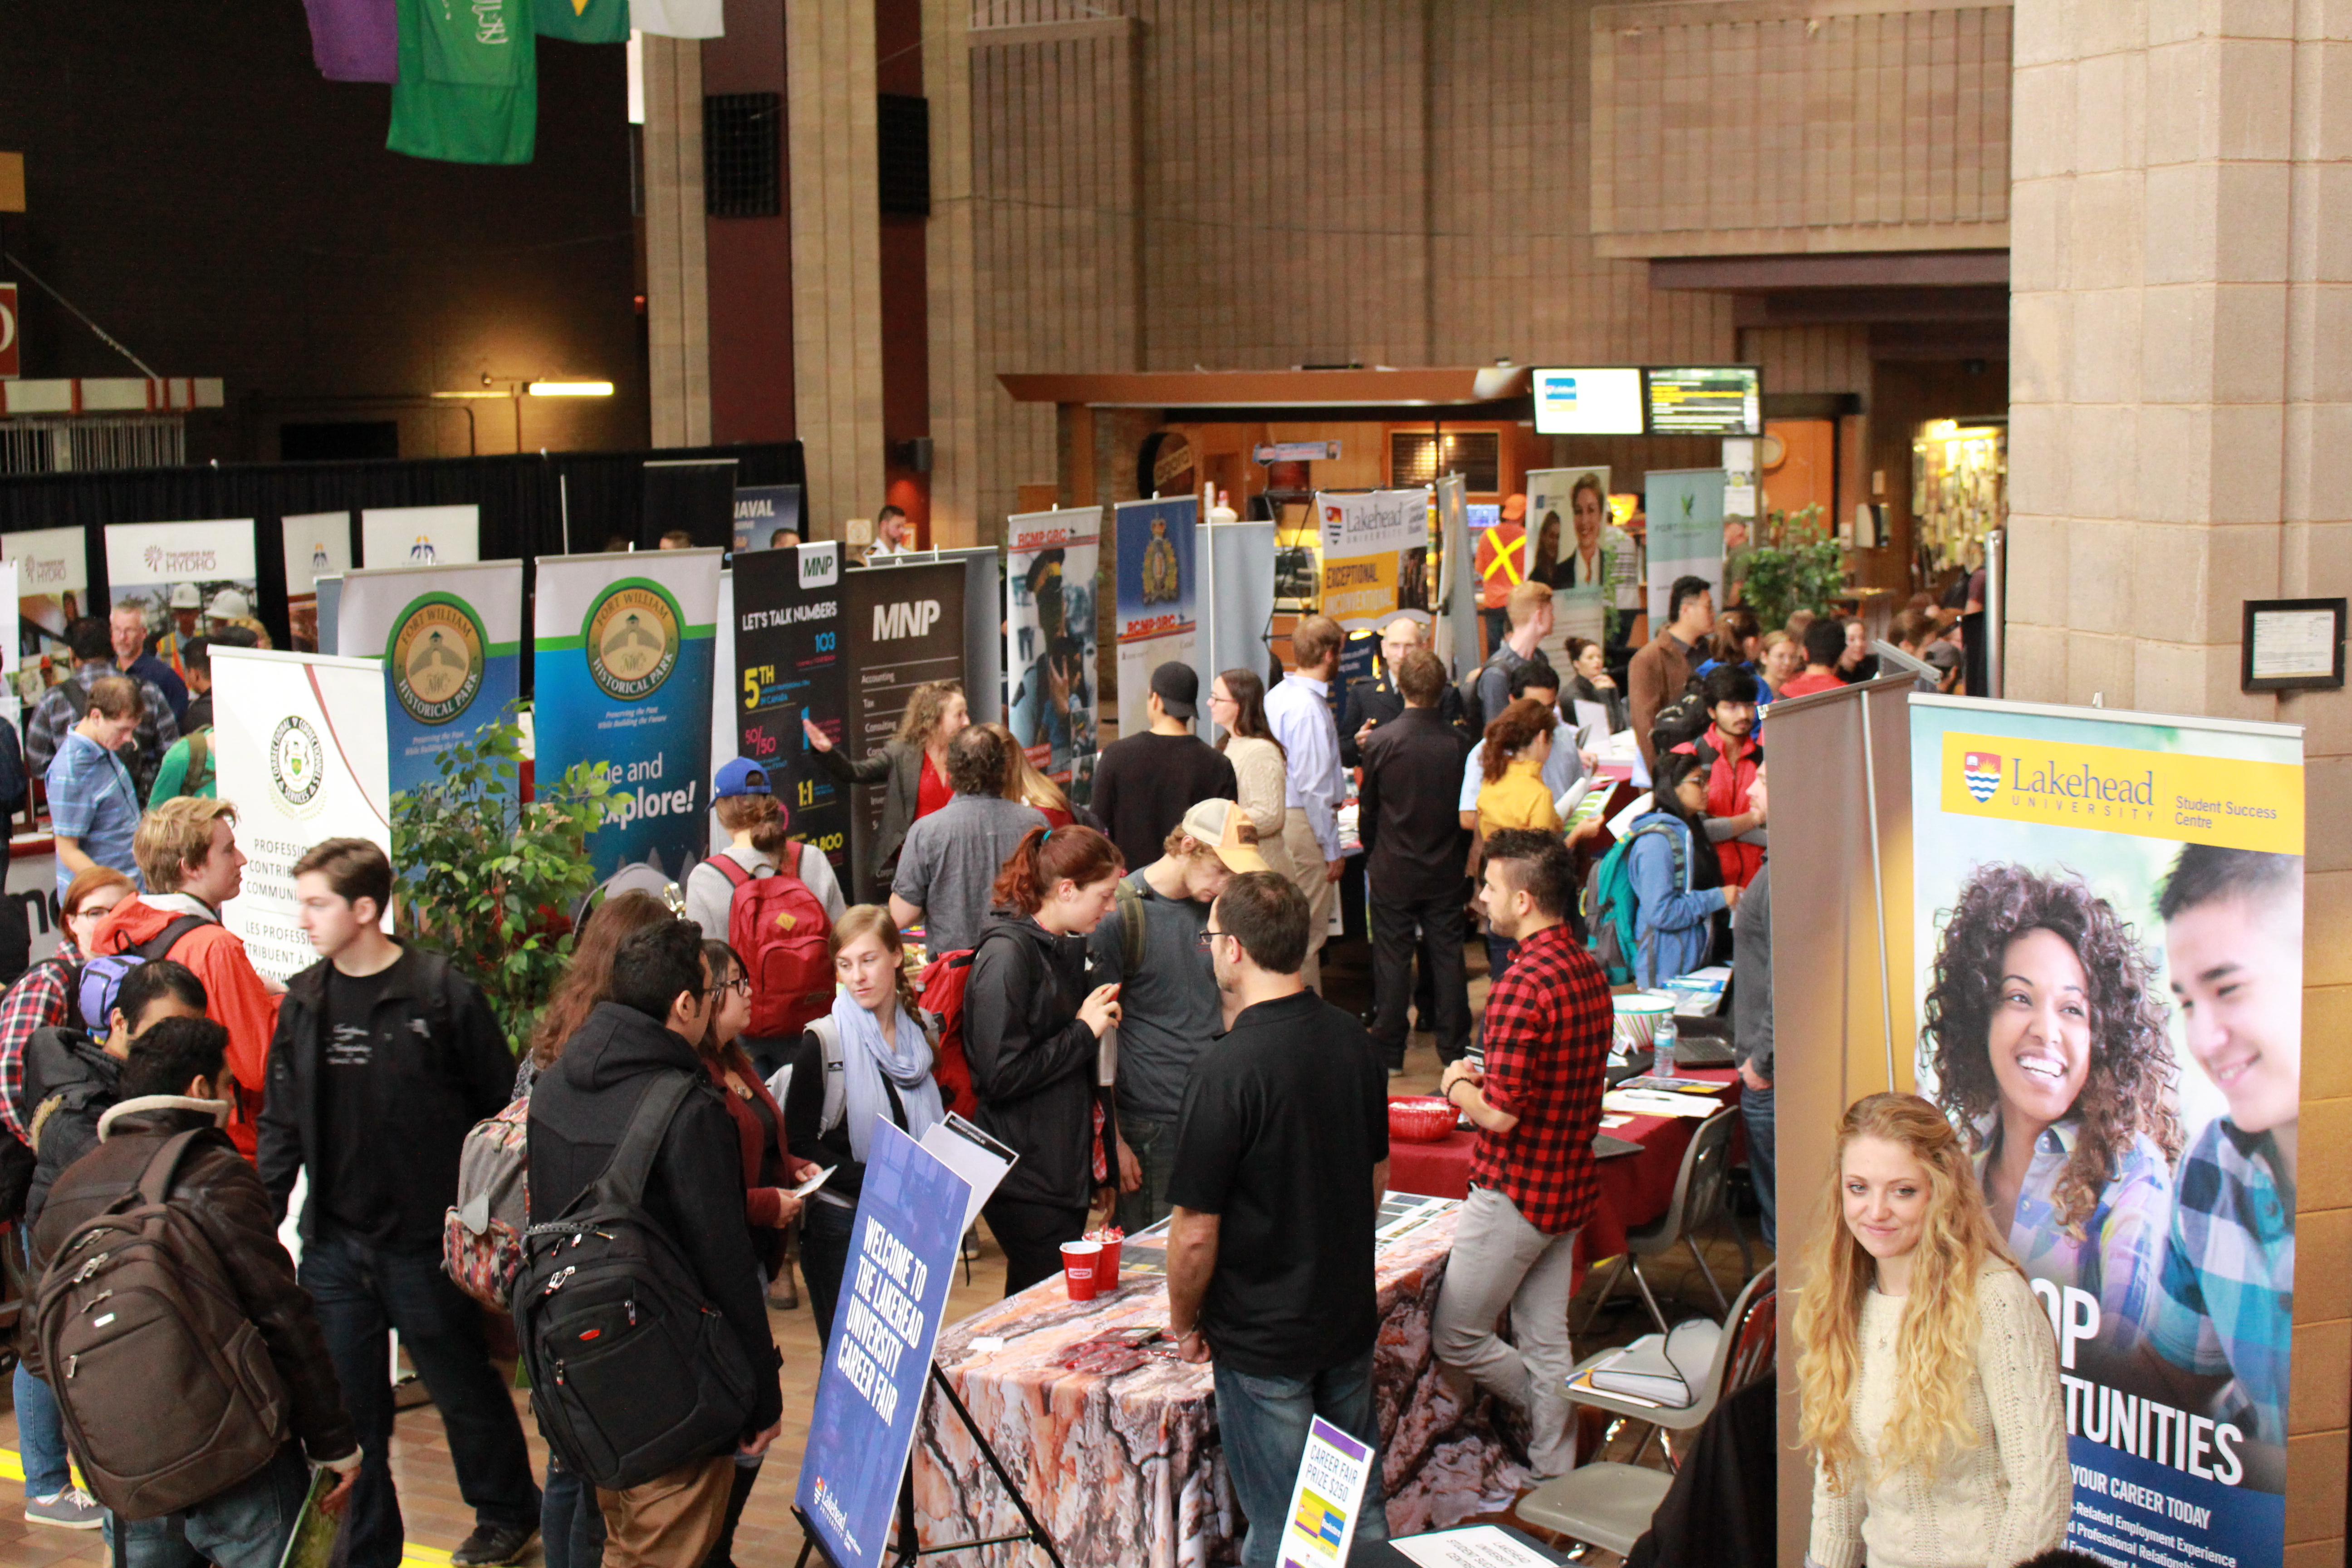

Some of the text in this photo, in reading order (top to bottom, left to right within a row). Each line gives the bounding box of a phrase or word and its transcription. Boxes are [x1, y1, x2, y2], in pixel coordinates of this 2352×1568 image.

[1346, 502, 1403, 532] Lakehead
[37, 567, 66, 583] HYDRO
[166, 557, 216, 573] HYDRO
[804, 556, 833, 578] MNP
[596, 592, 668, 626] FORT WILLIAM
[742, 601, 838, 631] LET'S TALK NUMBERS
[872, 599, 941, 642] MNP
[402, 608, 471, 645] FORT WILLIAM
[815, 632, 836, 652] 103
[593, 652, 673, 694] HISTORICAL PARK
[862, 672, 895, 684] Accounting
[399, 671, 478, 717] HISTORICAL PARK
[863, 699, 875, 709] Tax
[745, 725, 776, 755] 50/50
[865, 720, 897, 733] Consulting
[627, 752, 662, 782] and
[2012, 758, 2154, 806] Lakehead
[598, 780, 697, 831] xplore!
[798, 779, 813, 807] 1:1
[2176, 796, 2277, 820] Student Success
[2012, 795, 2154, 822] UNIVERSITY
[2175, 812, 2212, 829] Centre
[246, 921, 260, 935] LES
[863, 1215, 927, 1302] WELCOME TO
[855, 1254, 924, 1349] THE LAKEHEAD
[846, 1294, 904, 1378] UNIVERSITY
[838, 1333, 898, 1427] CAREER FAIR
[1310, 1444, 1358, 1486] CAREER FAIR
[1305, 1463, 1349, 1502] PRIZE $250
[2070, 1463, 2212, 1530] YOUR CAREER TODAY
[821, 1485, 848, 1531] Lakehead
[1321, 1518, 1343, 1538] Bookstore
[2070, 1501, 2237, 1568] -Related Employment Experience
[2077, 1522, 2138, 1555] Professional
[1475, 1544, 1516, 1566] UNIVERSITY
[1493, 1542, 1531, 1563] LAKEHEAD
